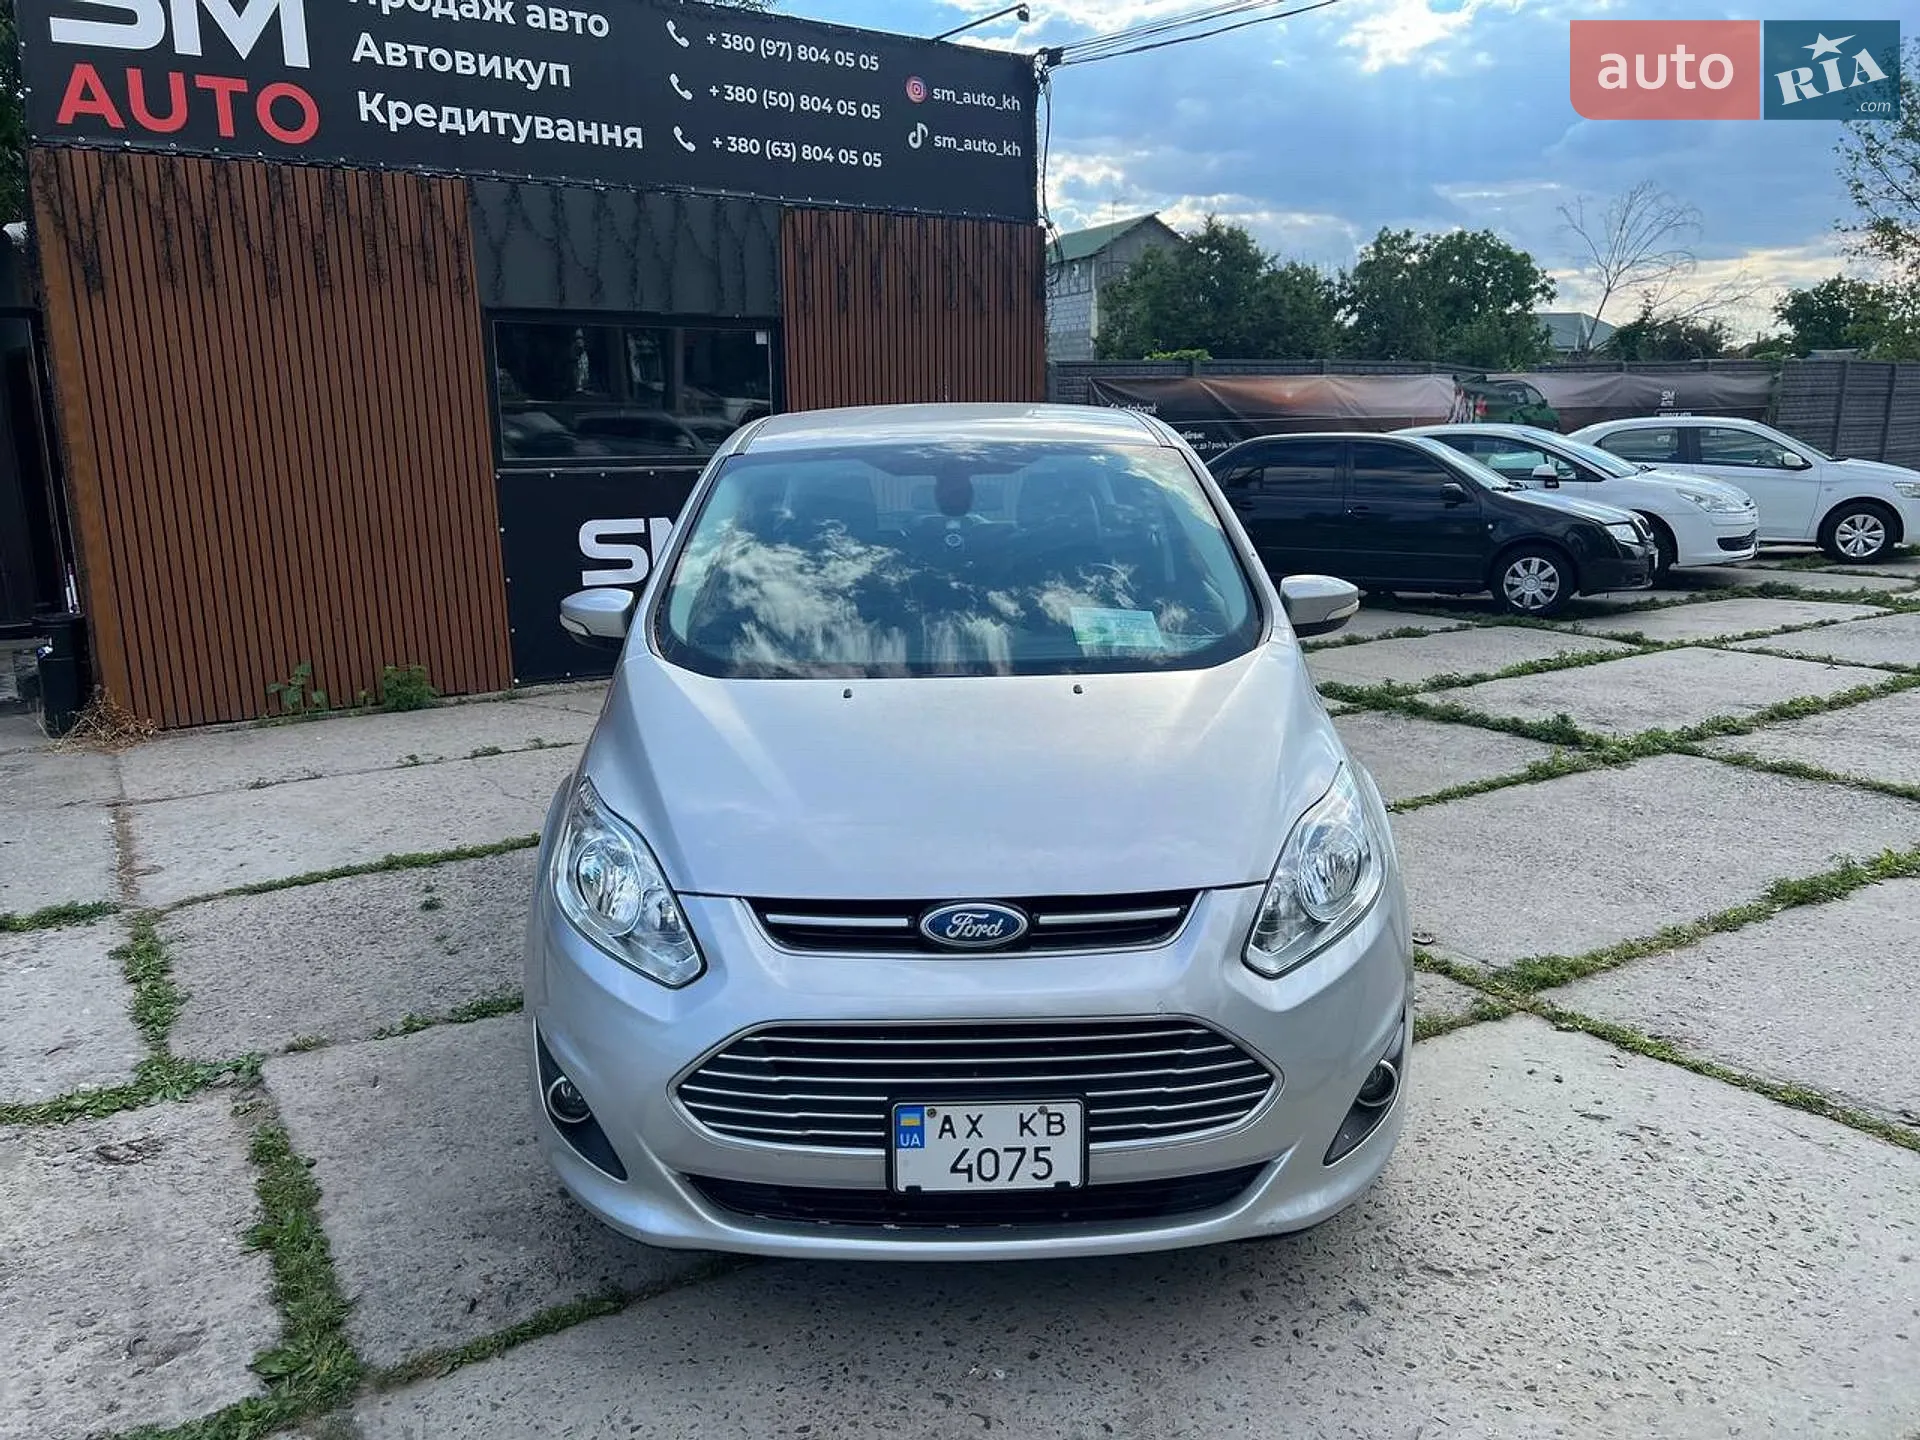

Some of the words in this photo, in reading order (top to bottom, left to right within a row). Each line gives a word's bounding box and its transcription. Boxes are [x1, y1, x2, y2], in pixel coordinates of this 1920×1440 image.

[349, 0, 516, 25] одаж
[526, 4, 610, 37] авто
[351, 32, 571, 91] Автовикуп
[721, 33, 755, 53] 380
[760, 38, 793, 62] (97)
[797, 45, 831, 64] 804
[834, 51, 855, 68] 05
[859, 54, 879, 71] 05
[56, 63, 320, 144] AUTO
[723, 84, 758, 103] 380
[763, 89, 795, 113] (50)
[799, 95, 834, 114] 804
[836, 100, 857, 117] 05
[860, 103, 881, 120] 05
[932, 88, 1021, 111] sm_auto_kh
[357, 91, 643, 149] Кредитування
[727, 136, 761, 155] 380
[765, 140, 797, 163] (63)
[801, 145, 835, 163] 804
[838, 149, 859, 166] 05
[862, 152, 882, 168] 05
[934, 135, 1022, 157] sm_auto_kh
[946, 912, 1004, 938] Ford
[900, 1133, 921, 1147] UA
[938, 1114, 984, 1140] AX
[1019, 1112, 1066, 1138] KB
[949, 1146, 1053, 1183] 4075
